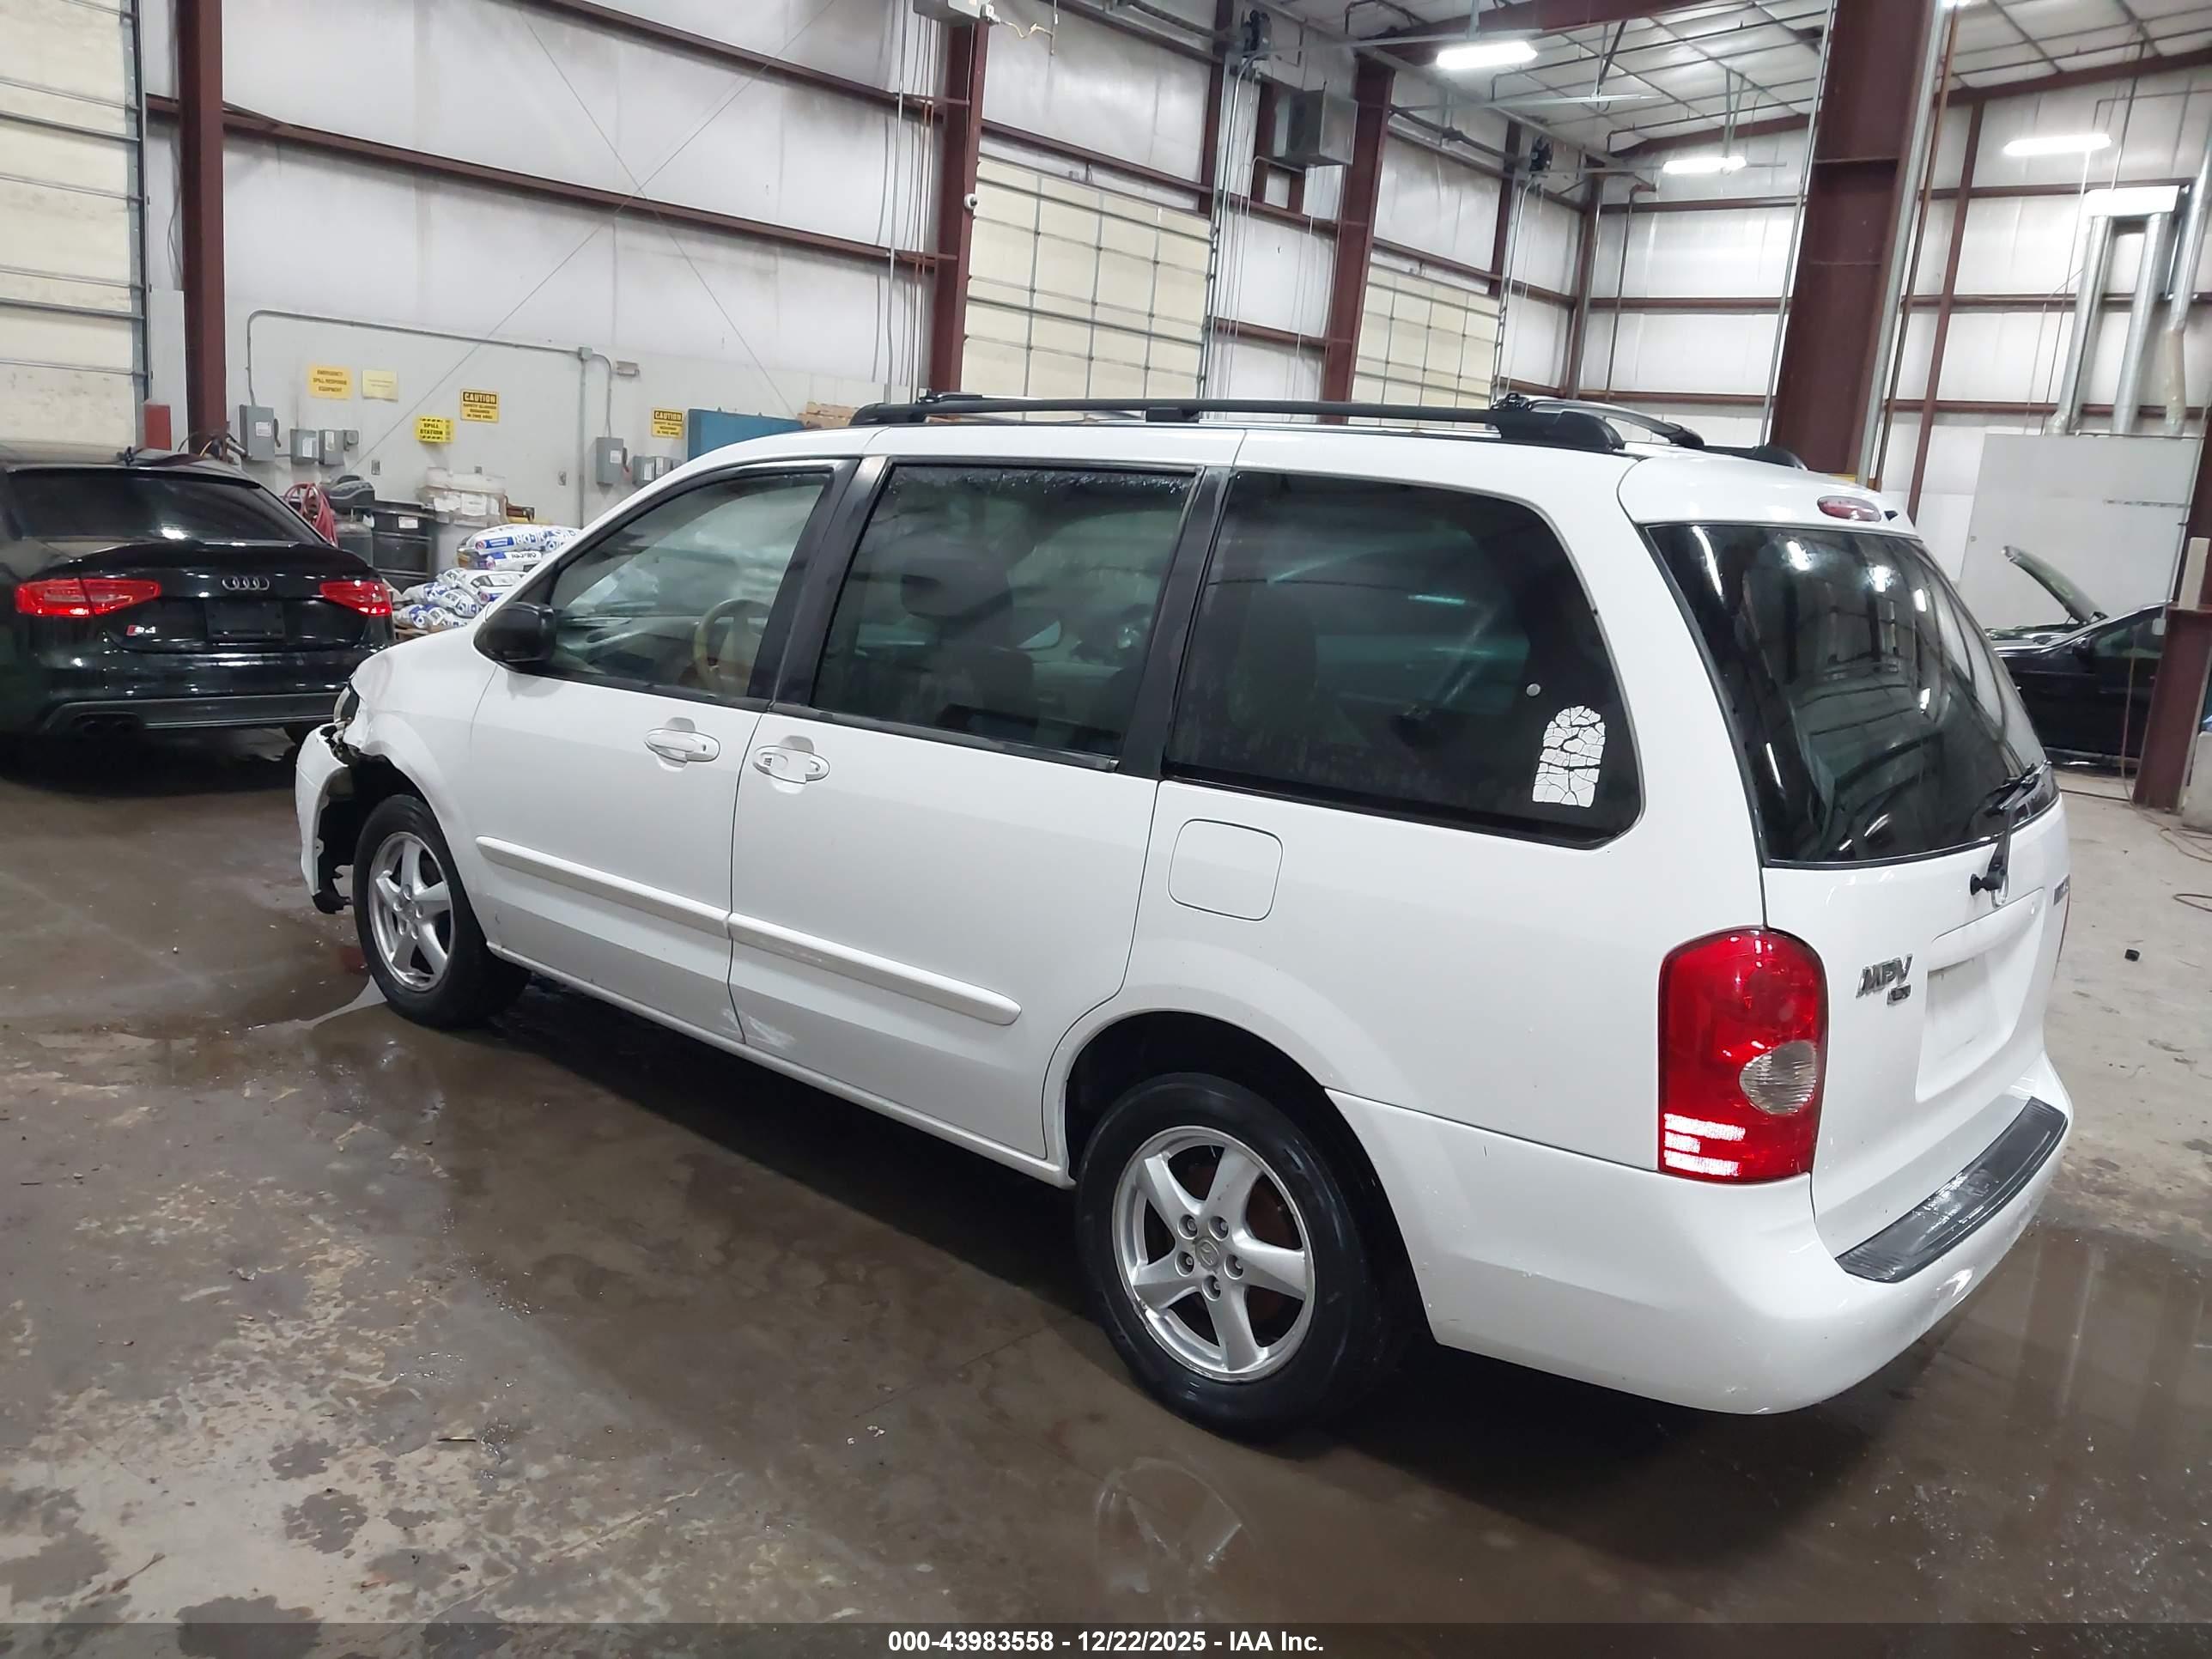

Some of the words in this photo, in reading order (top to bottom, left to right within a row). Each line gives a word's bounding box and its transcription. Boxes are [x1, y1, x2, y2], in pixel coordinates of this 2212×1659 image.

[465, 393, 495, 403] CAUTION
[655, 411, 681, 421] CAUTION
[1856, 953, 1913, 998] MPV
